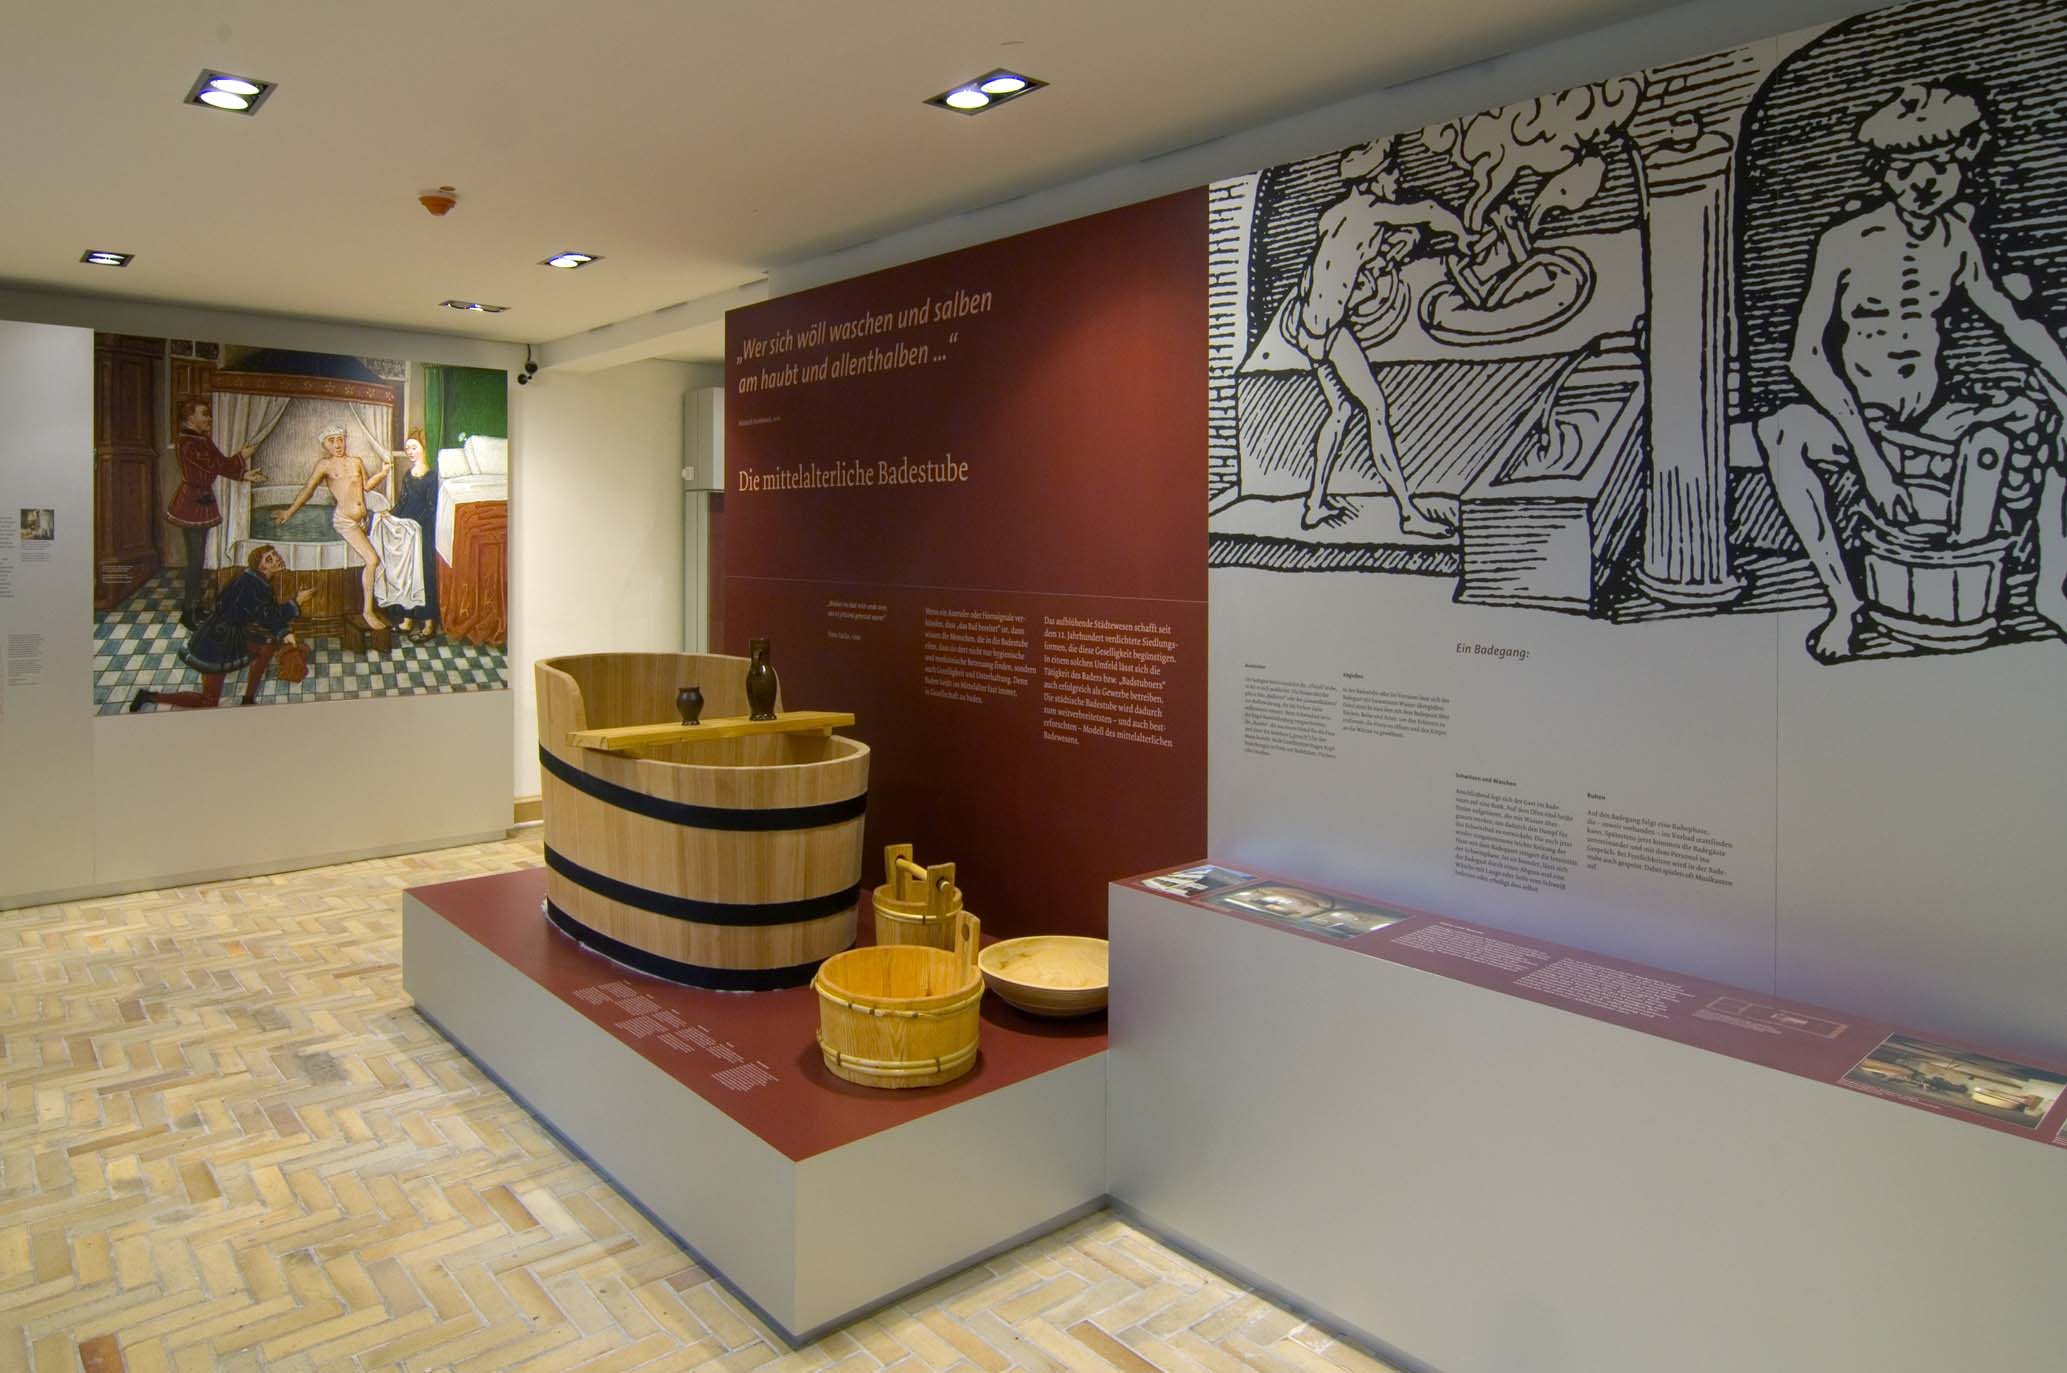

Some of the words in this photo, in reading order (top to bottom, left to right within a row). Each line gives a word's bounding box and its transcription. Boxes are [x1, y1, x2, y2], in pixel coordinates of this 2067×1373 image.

[769, 329, 794, 355] sich
[797, 320, 827, 349] wöll
[829, 311, 894, 344] waschen
[898, 297, 931, 329] und
[933, 290, 992, 322] salben
[739, 375, 758, 394] am
[760, 363, 799, 391] haubt
[801, 355, 829, 383] und
[831, 341, 929, 379] allenthalben
[739, 468, 760, 492] Die
[763, 460, 874, 490] mittelalterliche
[877, 453, 969, 485] Badestube
[1456, 643, 1472, 654] Ein
[1474, 643, 1530, 660] Badegang:
